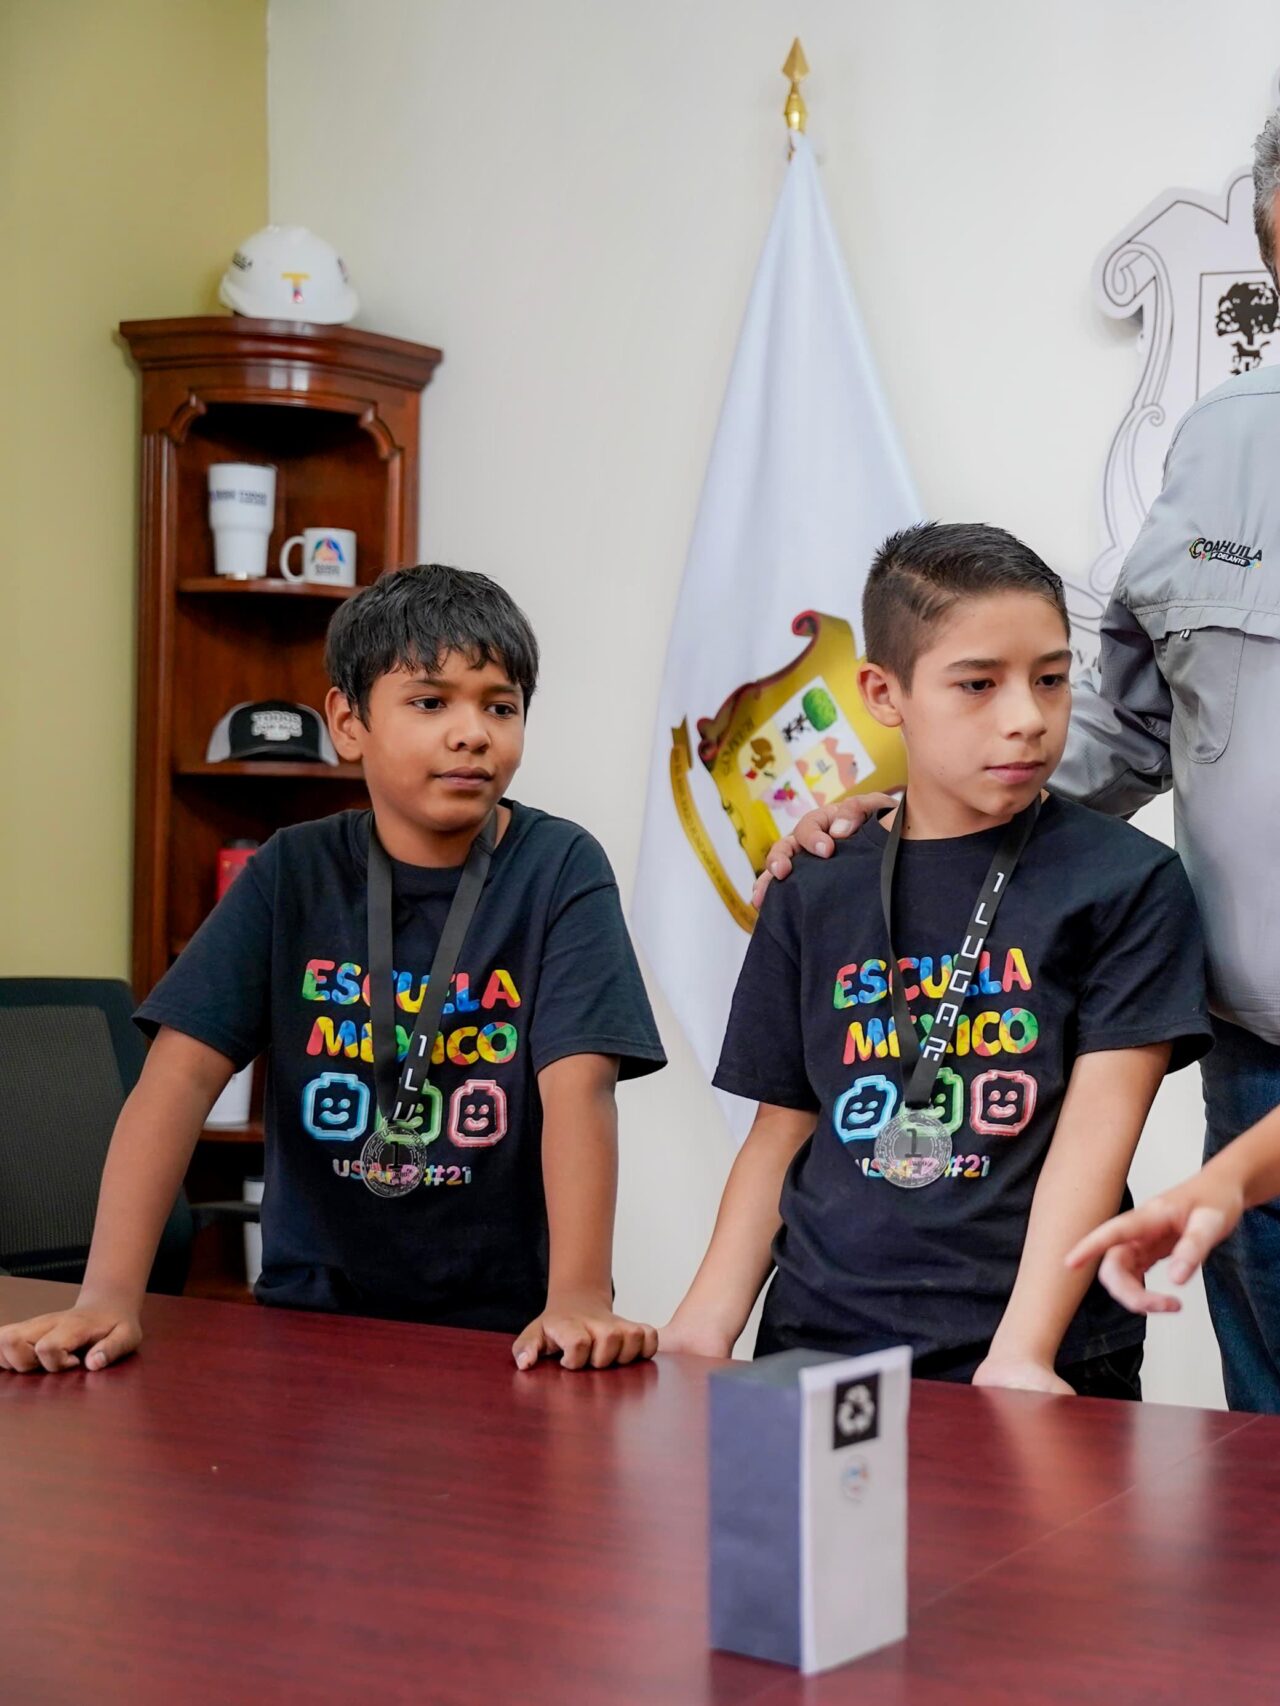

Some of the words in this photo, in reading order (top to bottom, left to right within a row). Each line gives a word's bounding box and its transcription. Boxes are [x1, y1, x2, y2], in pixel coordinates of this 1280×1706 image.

[1189, 537, 1262, 562] COAHUILA
[301, 958, 522, 1015] ESULA
[424, 1163, 472, 1187] #21
[944, 1153, 991, 1178] #21
